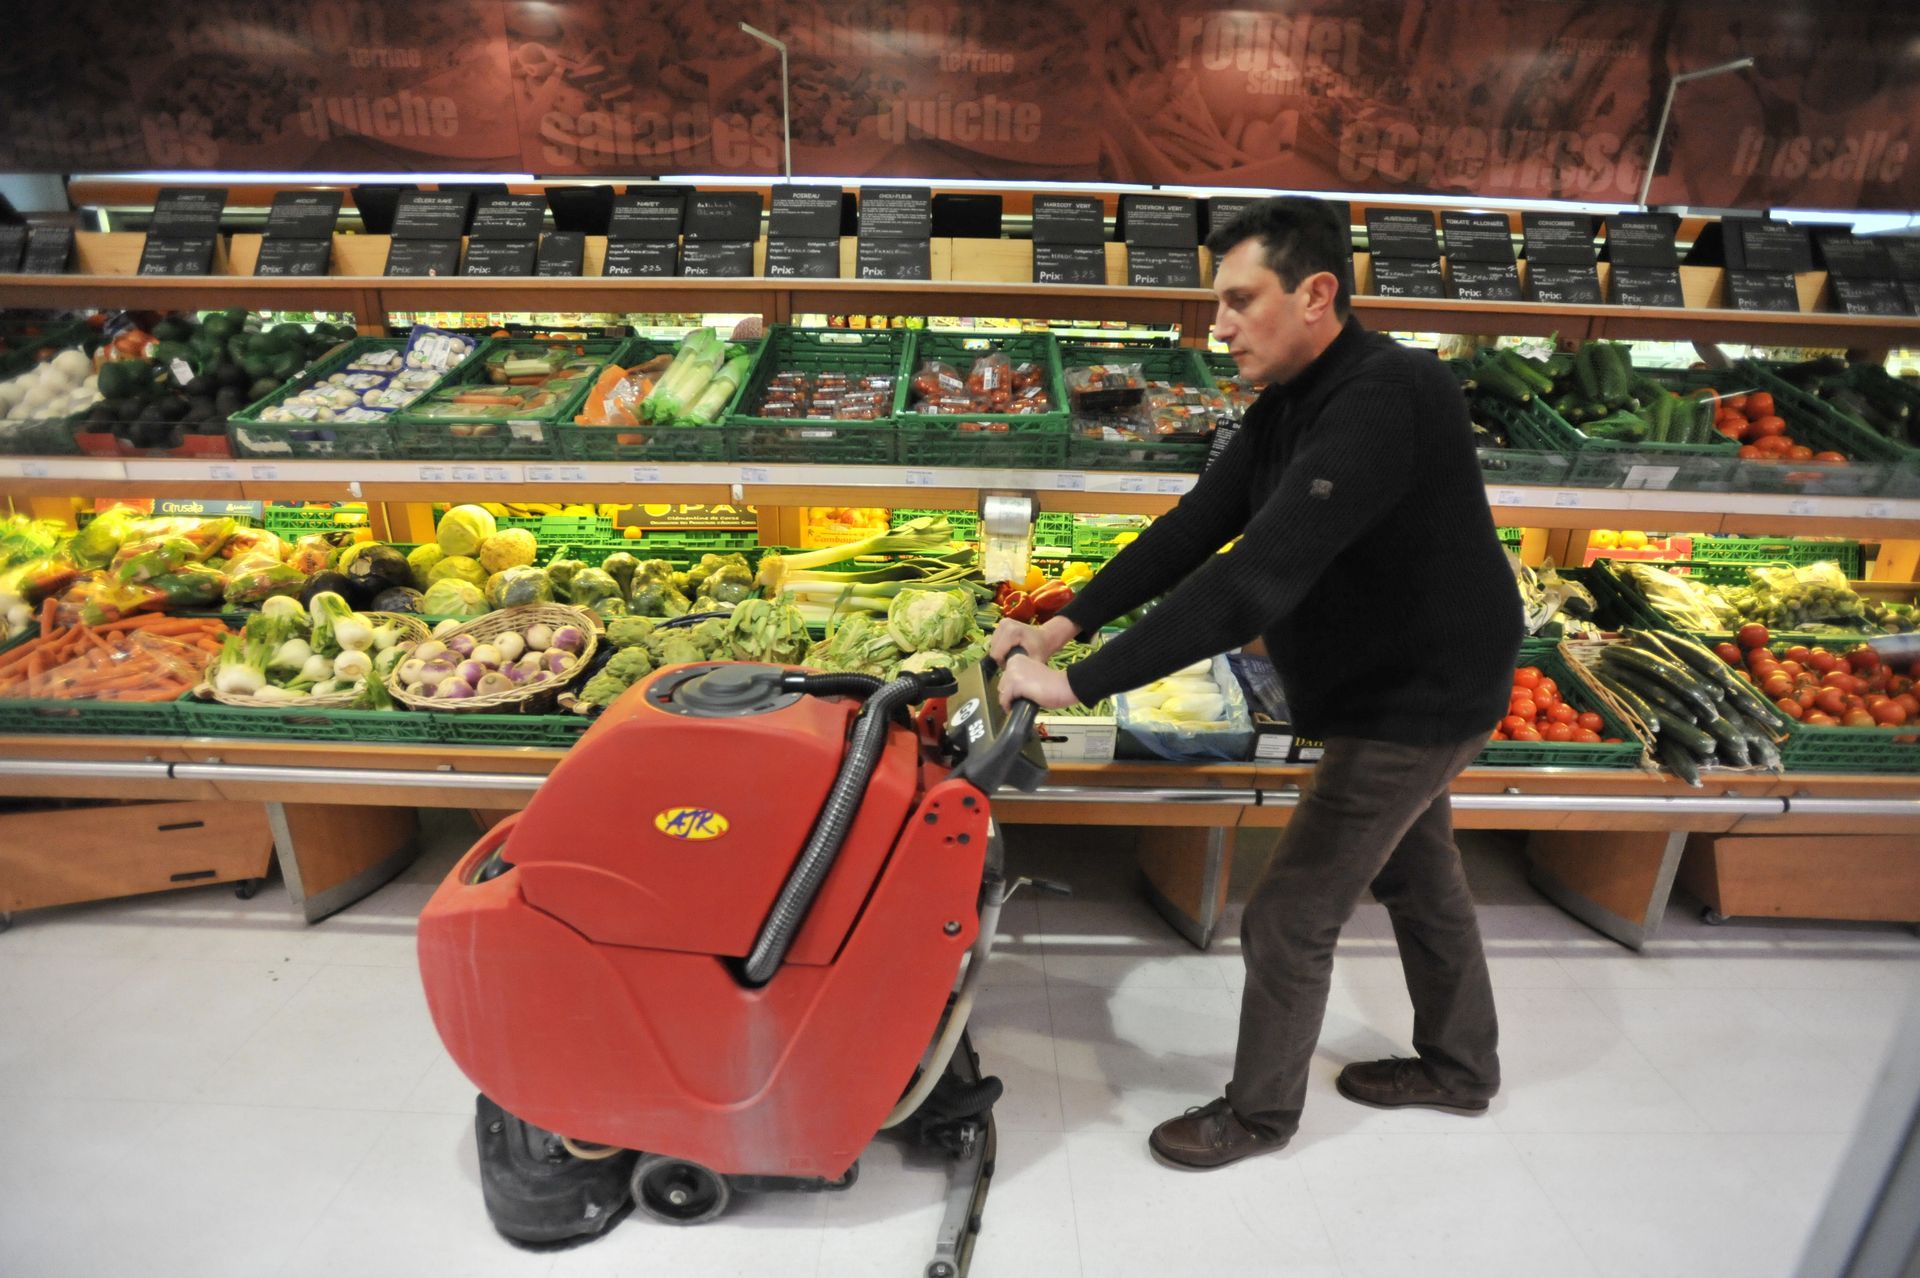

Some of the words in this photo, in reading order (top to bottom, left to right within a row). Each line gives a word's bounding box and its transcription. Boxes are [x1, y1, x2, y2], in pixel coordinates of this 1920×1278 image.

[938, 49, 1015, 73] terrine
[299, 91, 460, 141] quiche
[877, 93, 1042, 145] quiche
[540, 103, 784, 168] salades
[467, 264, 492, 275] Prix:
[608, 265, 633, 275] Prix:
[684, 265, 710, 276] Prix:
[770, 265, 796, 275] Prix:
[861, 266, 889, 277] Prix:
[1039, 270, 1065, 281] Prix:
[1134, 273, 1160, 285] Prix:
[1380, 283, 1406, 295] Prix:
[1458, 287, 1484, 298] Prix:
[1538, 290, 1563, 301] Prix:
[968, 718, 985, 744] 532
[665, 809, 716, 839] AJR
